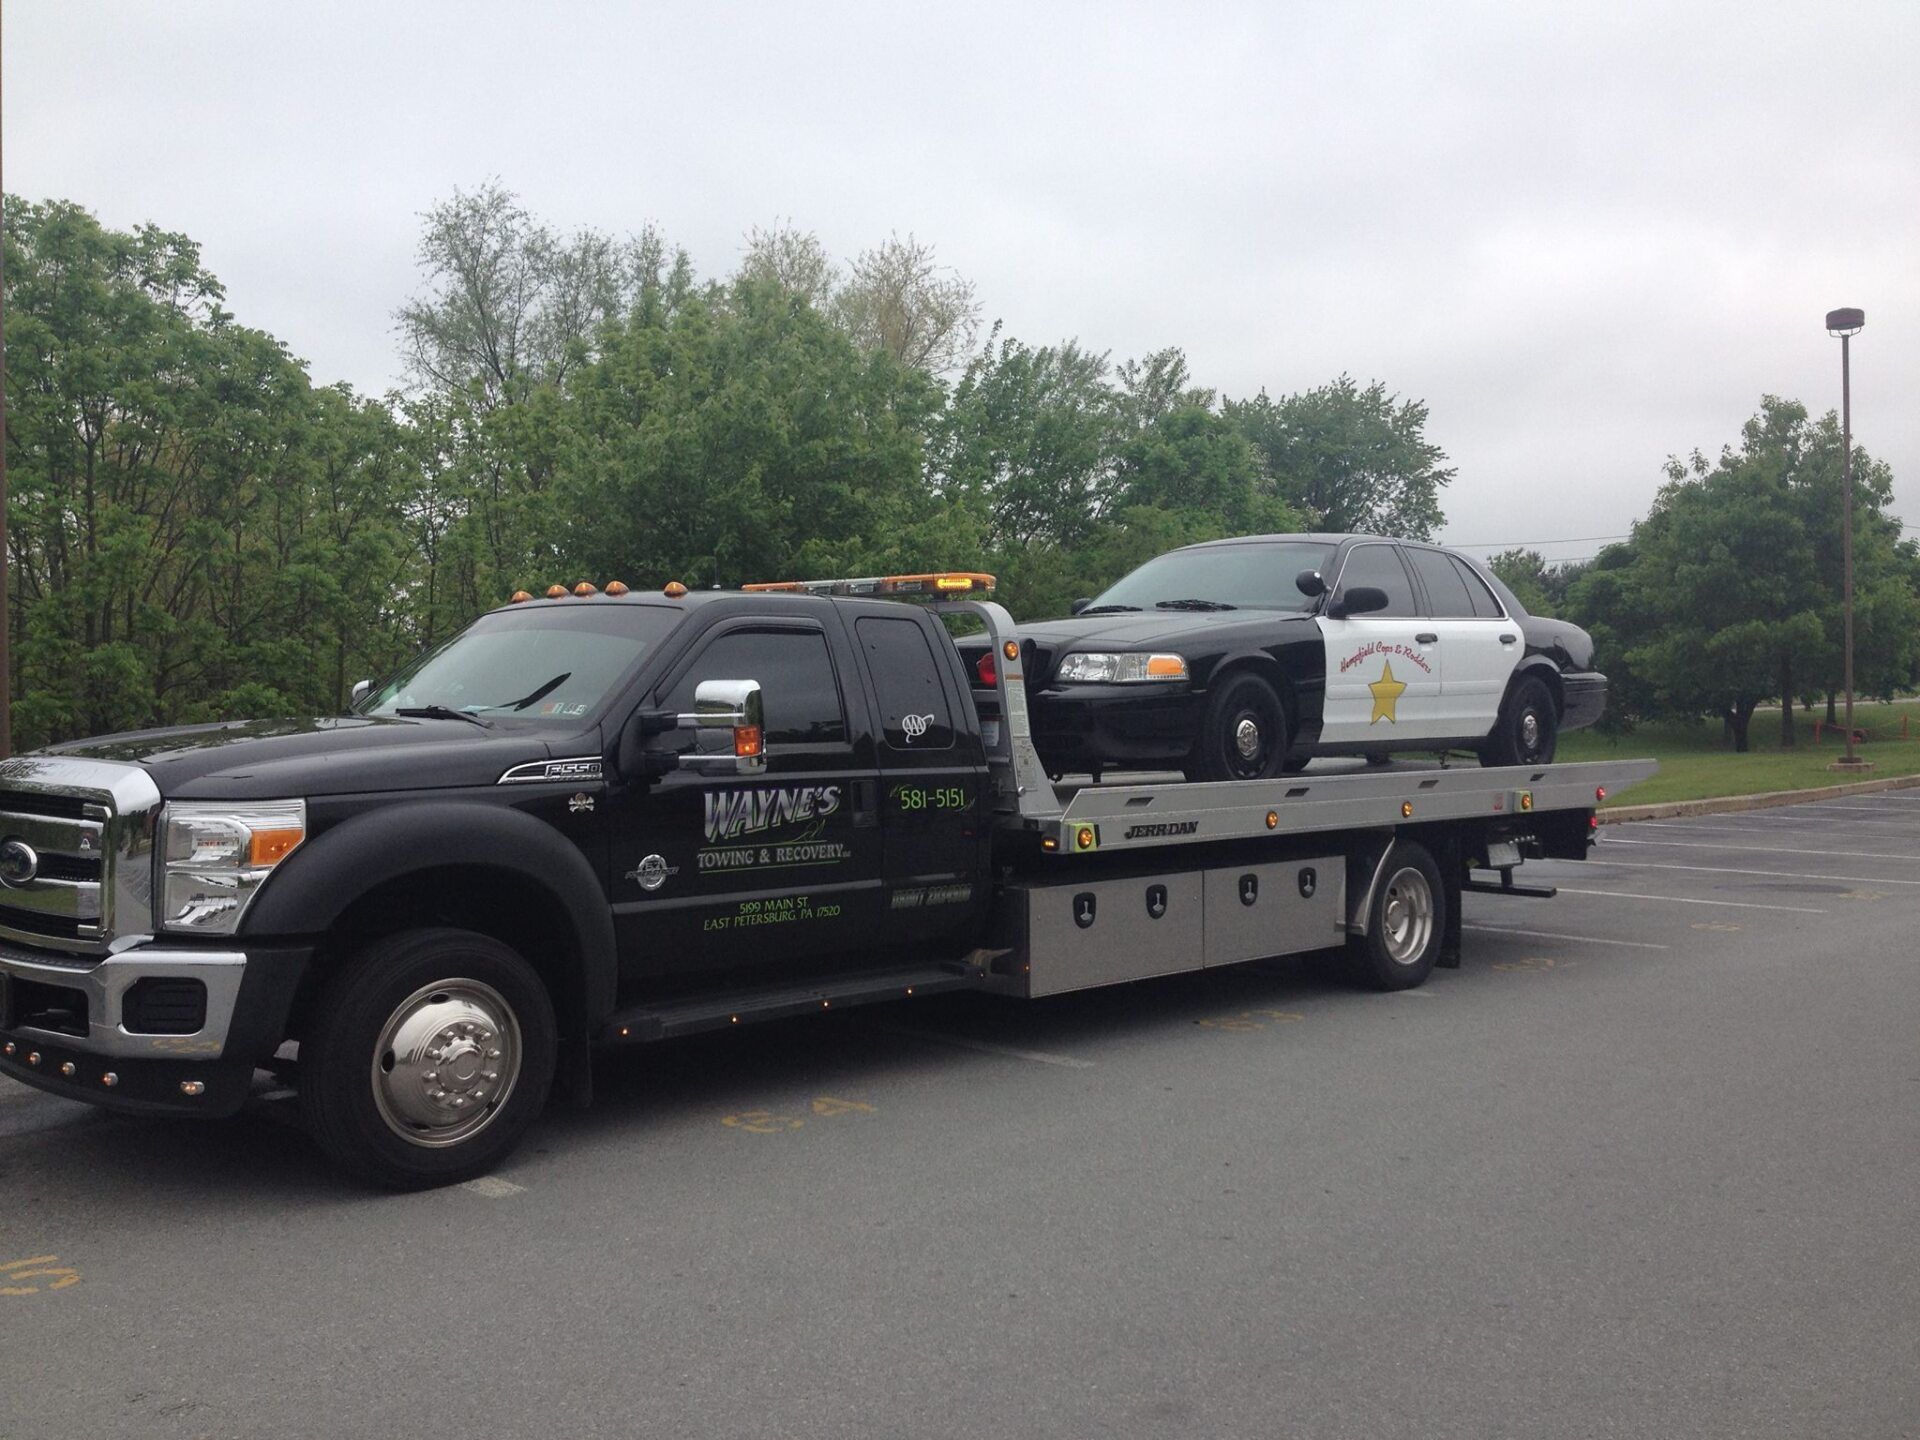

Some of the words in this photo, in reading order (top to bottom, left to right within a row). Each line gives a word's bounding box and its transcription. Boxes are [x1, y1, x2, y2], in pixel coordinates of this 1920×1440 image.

[1376, 641, 1393, 656] Cops
[1395, 645, 1402, 654] &
[1402, 646, 1432, 674] Rodders
[901, 788, 964, 809] 581-5151
[704, 785, 842, 843] WAYNE'S
[697, 851, 754, 868] TOWING
[759, 849, 770, 863] &
[776, 843, 843, 862] RECOVERY
[703, 917, 731, 931] EAST
[801, 908, 813, 919] PA
[816, 905, 841, 917] 17520
[739, 901, 761, 914] 5199
[764, 899, 794, 912] MAIN
